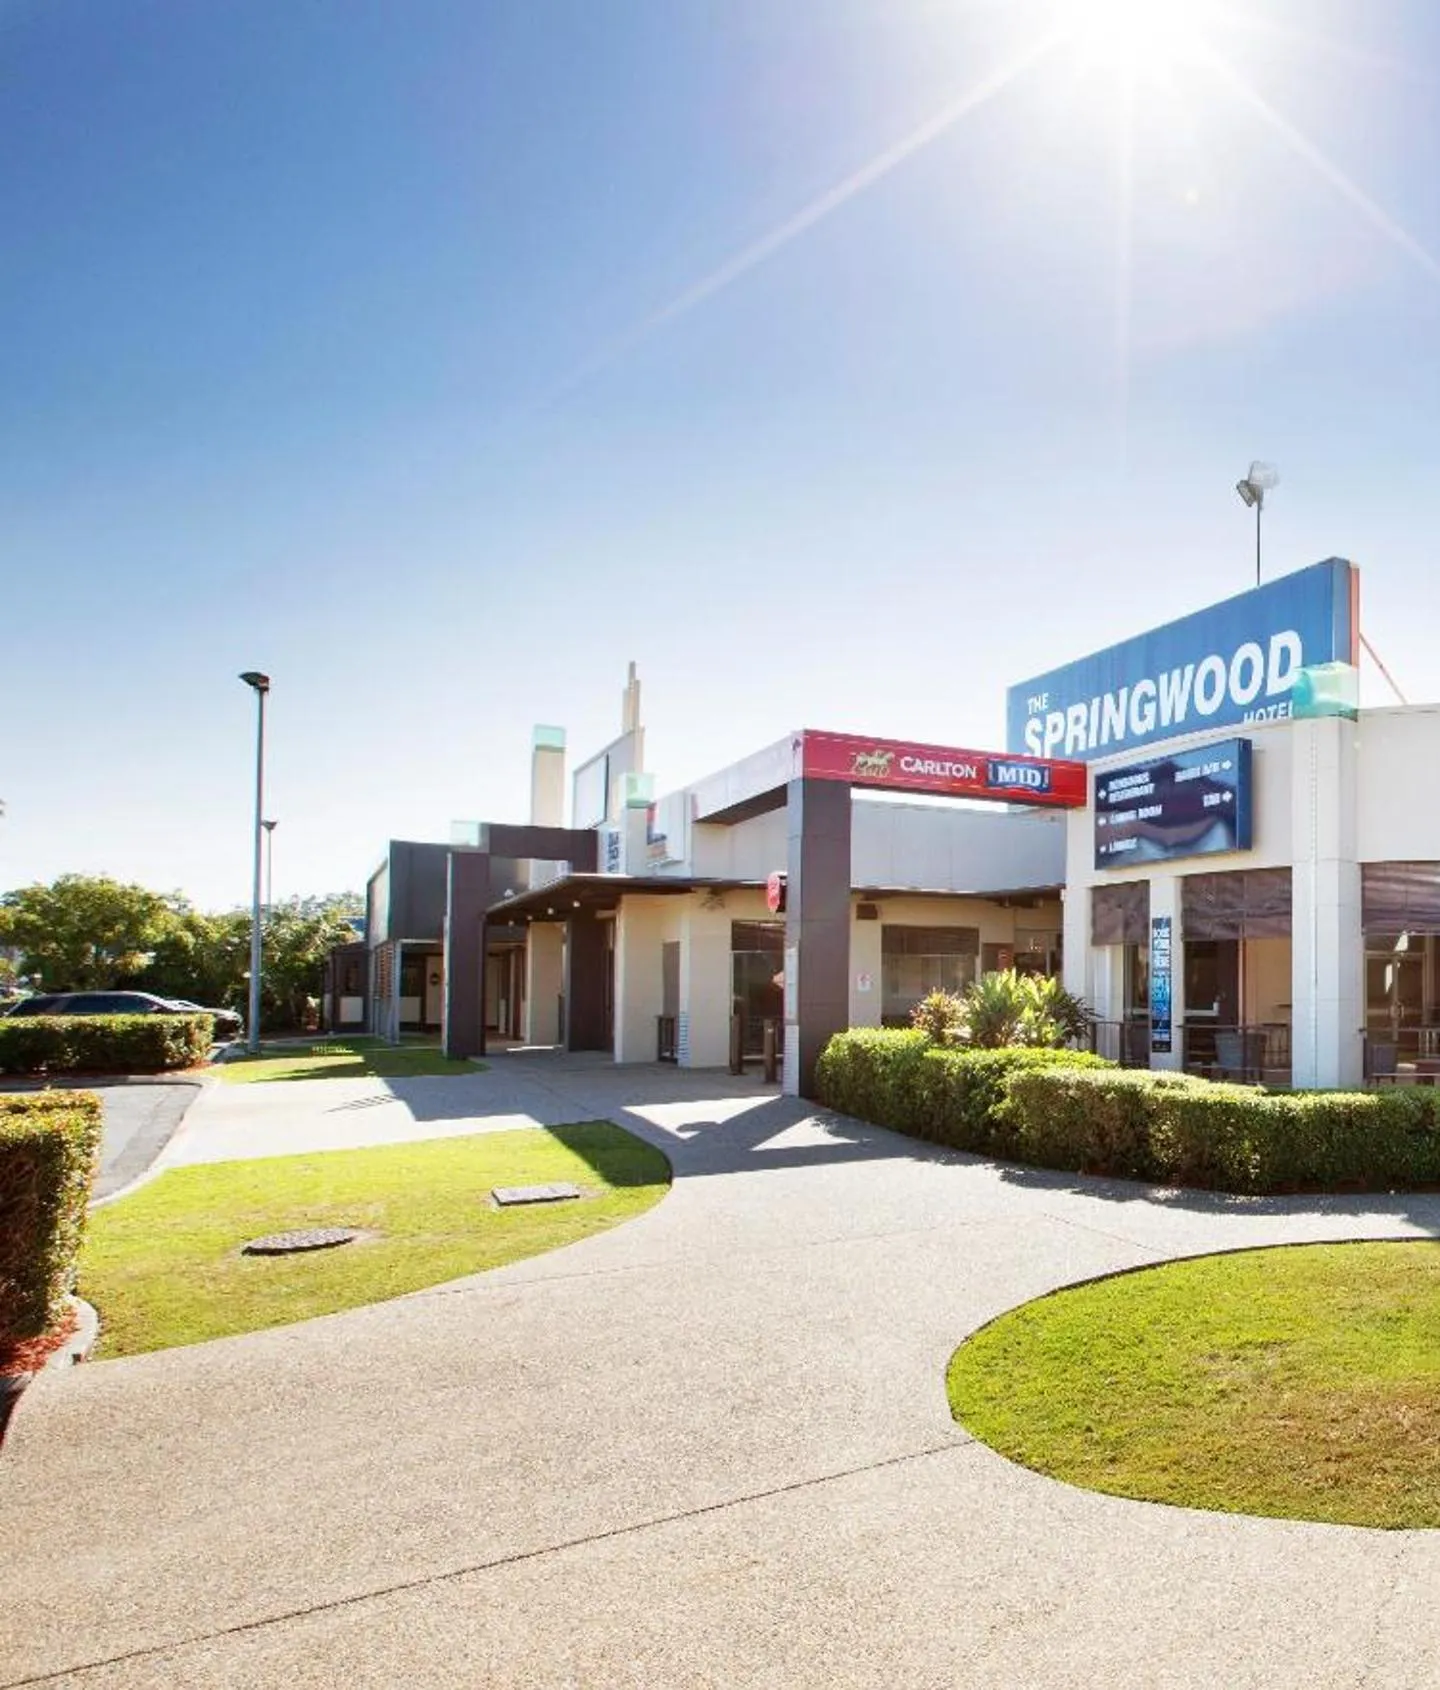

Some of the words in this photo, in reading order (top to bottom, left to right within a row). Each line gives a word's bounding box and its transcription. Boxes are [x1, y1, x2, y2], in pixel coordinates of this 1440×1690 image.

[1024, 629, 1303, 758] SPRINGWOOD
[1028, 692, 1049, 715] THE
[900, 756, 978, 779] CARLTON
[997, 766, 1042, 787] MID
